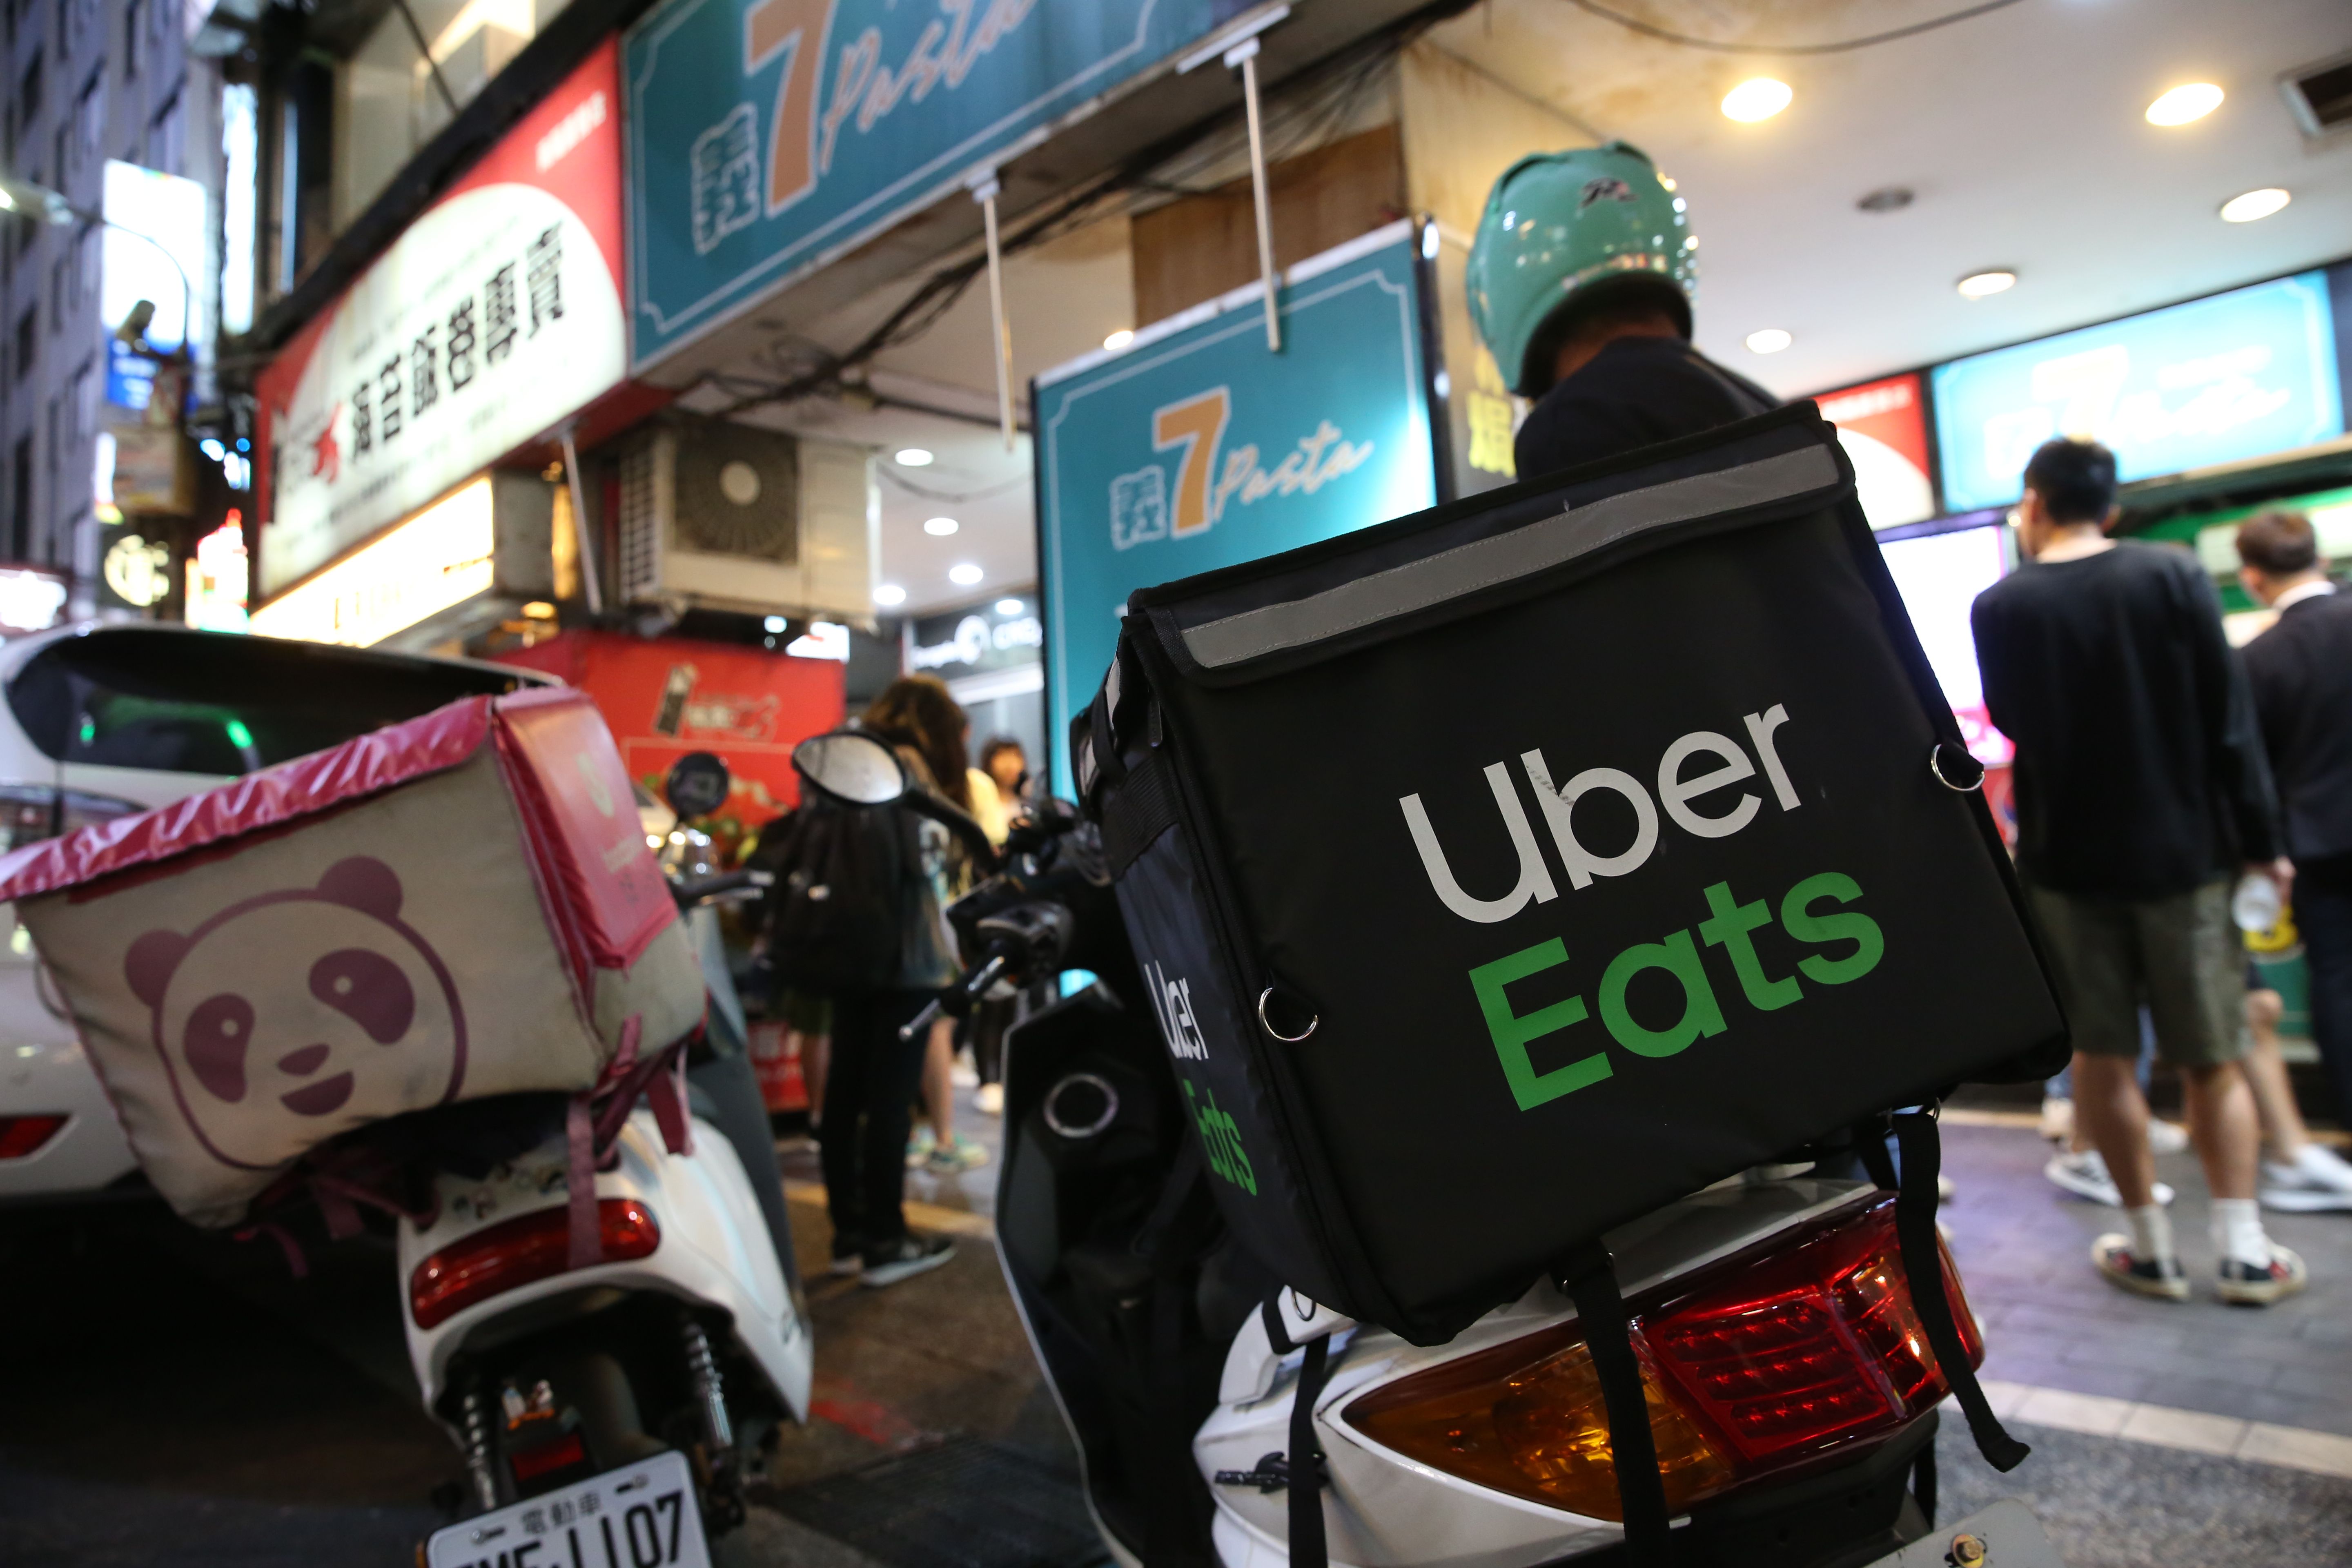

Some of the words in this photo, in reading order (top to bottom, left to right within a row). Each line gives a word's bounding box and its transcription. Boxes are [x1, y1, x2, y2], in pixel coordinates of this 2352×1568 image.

[743, 0, 835, 216] 7
[1152, 384, 1231, 539] 7
[1212, 419, 1375, 523] Pasta
[1399, 703, 1802, 923] Uber
[1468, 872, 1884, 1112] Eats
[1183, 1078, 1257, 1196] Eats
[452, 1490, 684, 1568] -1107
